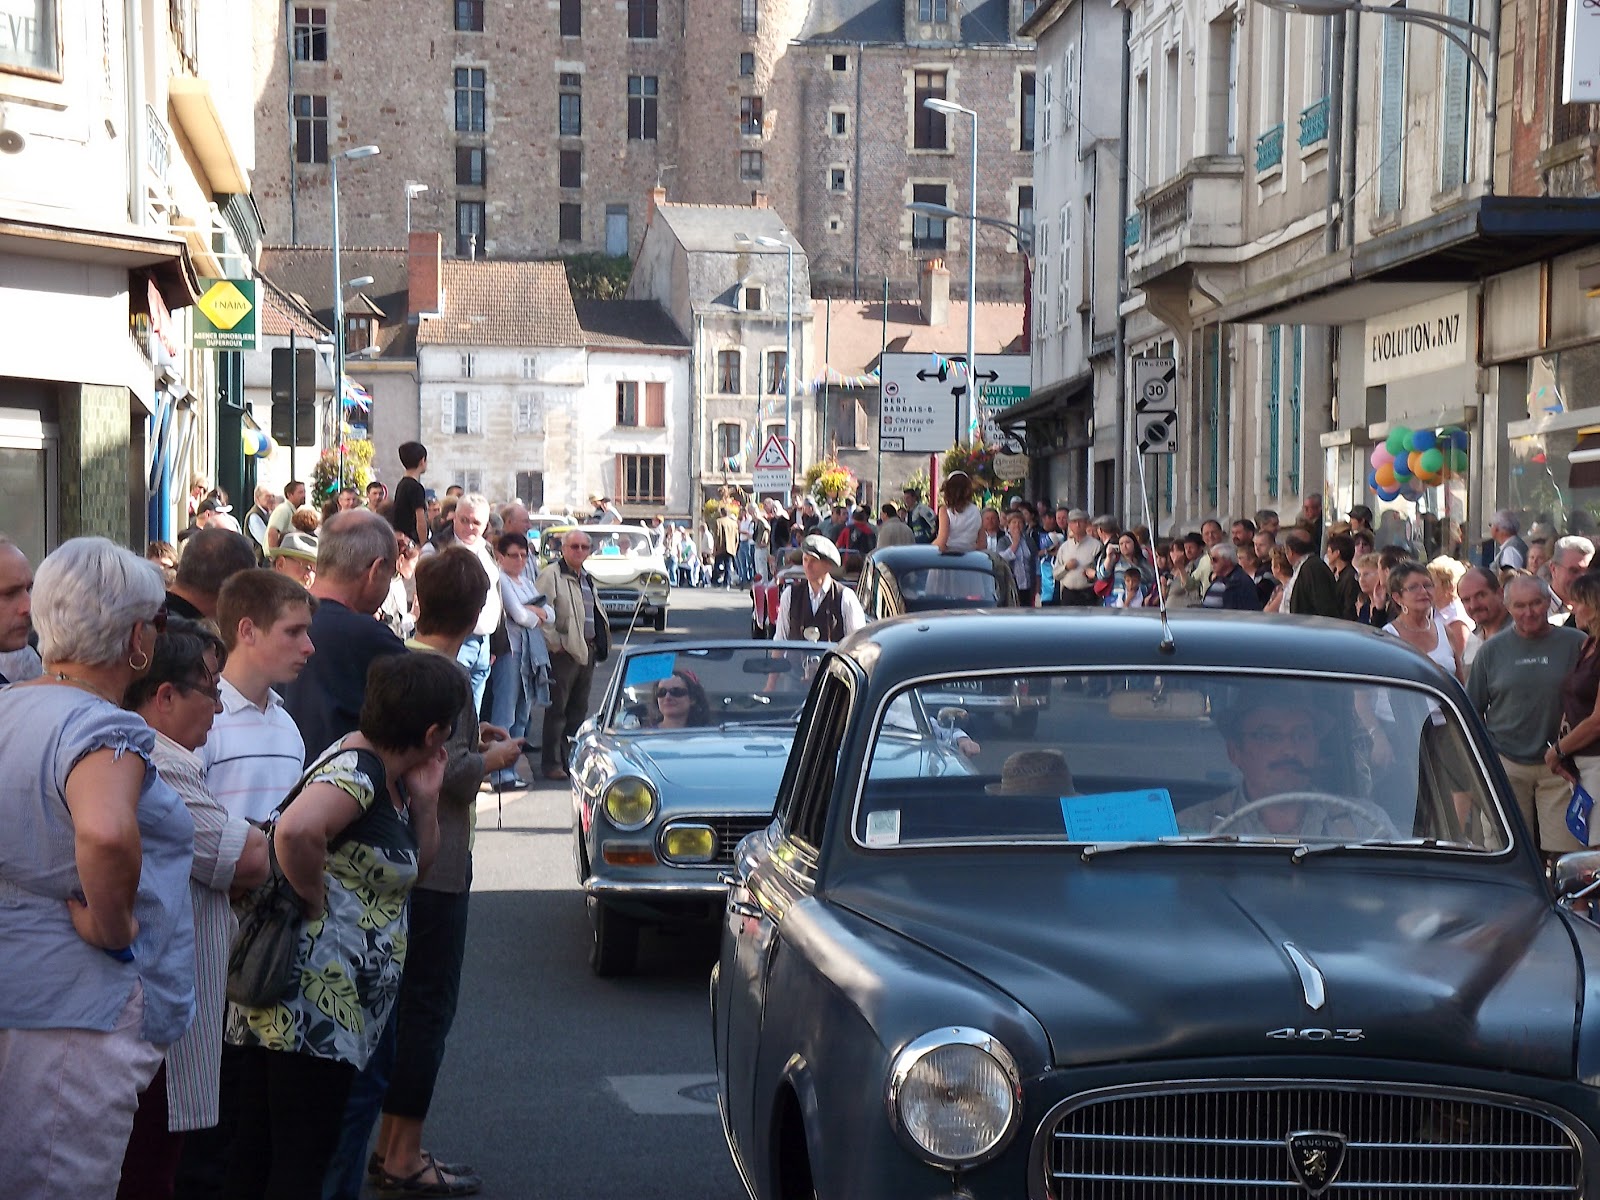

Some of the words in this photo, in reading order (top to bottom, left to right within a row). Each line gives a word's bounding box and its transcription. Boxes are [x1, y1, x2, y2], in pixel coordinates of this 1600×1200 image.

[1148, 385, 1164, 396] 30
[1265, 1027, 1366, 1042] 403
[1295, 1139, 1340, 1149] PEUGEOT
